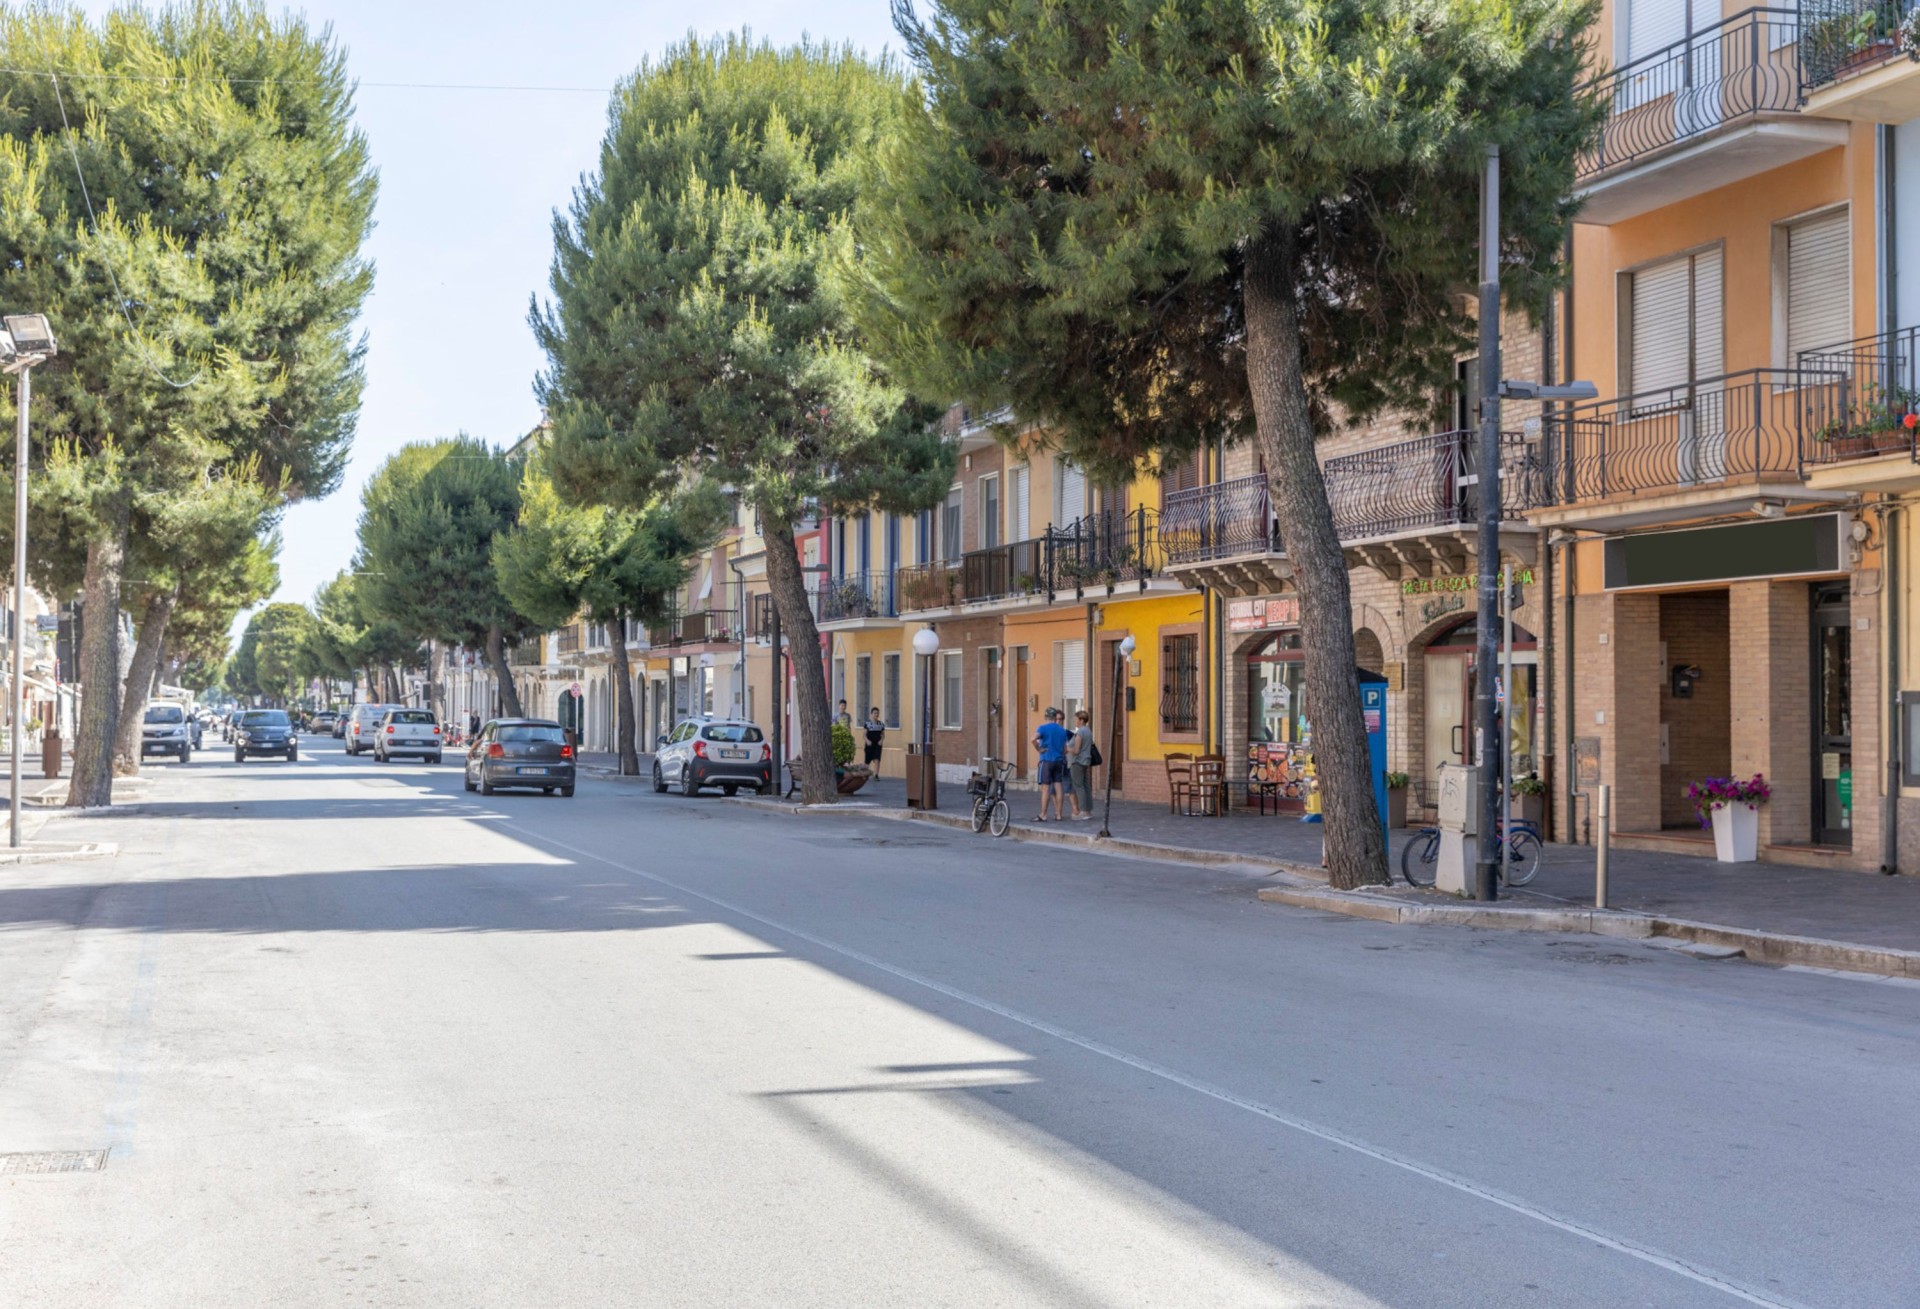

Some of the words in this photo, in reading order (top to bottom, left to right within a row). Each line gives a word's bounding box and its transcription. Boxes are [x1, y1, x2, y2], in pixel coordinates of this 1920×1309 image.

[1403, 579, 1429, 594] PASTA
[1253, 599, 1266, 616] CITY
[1367, 691, 1378, 704] P
